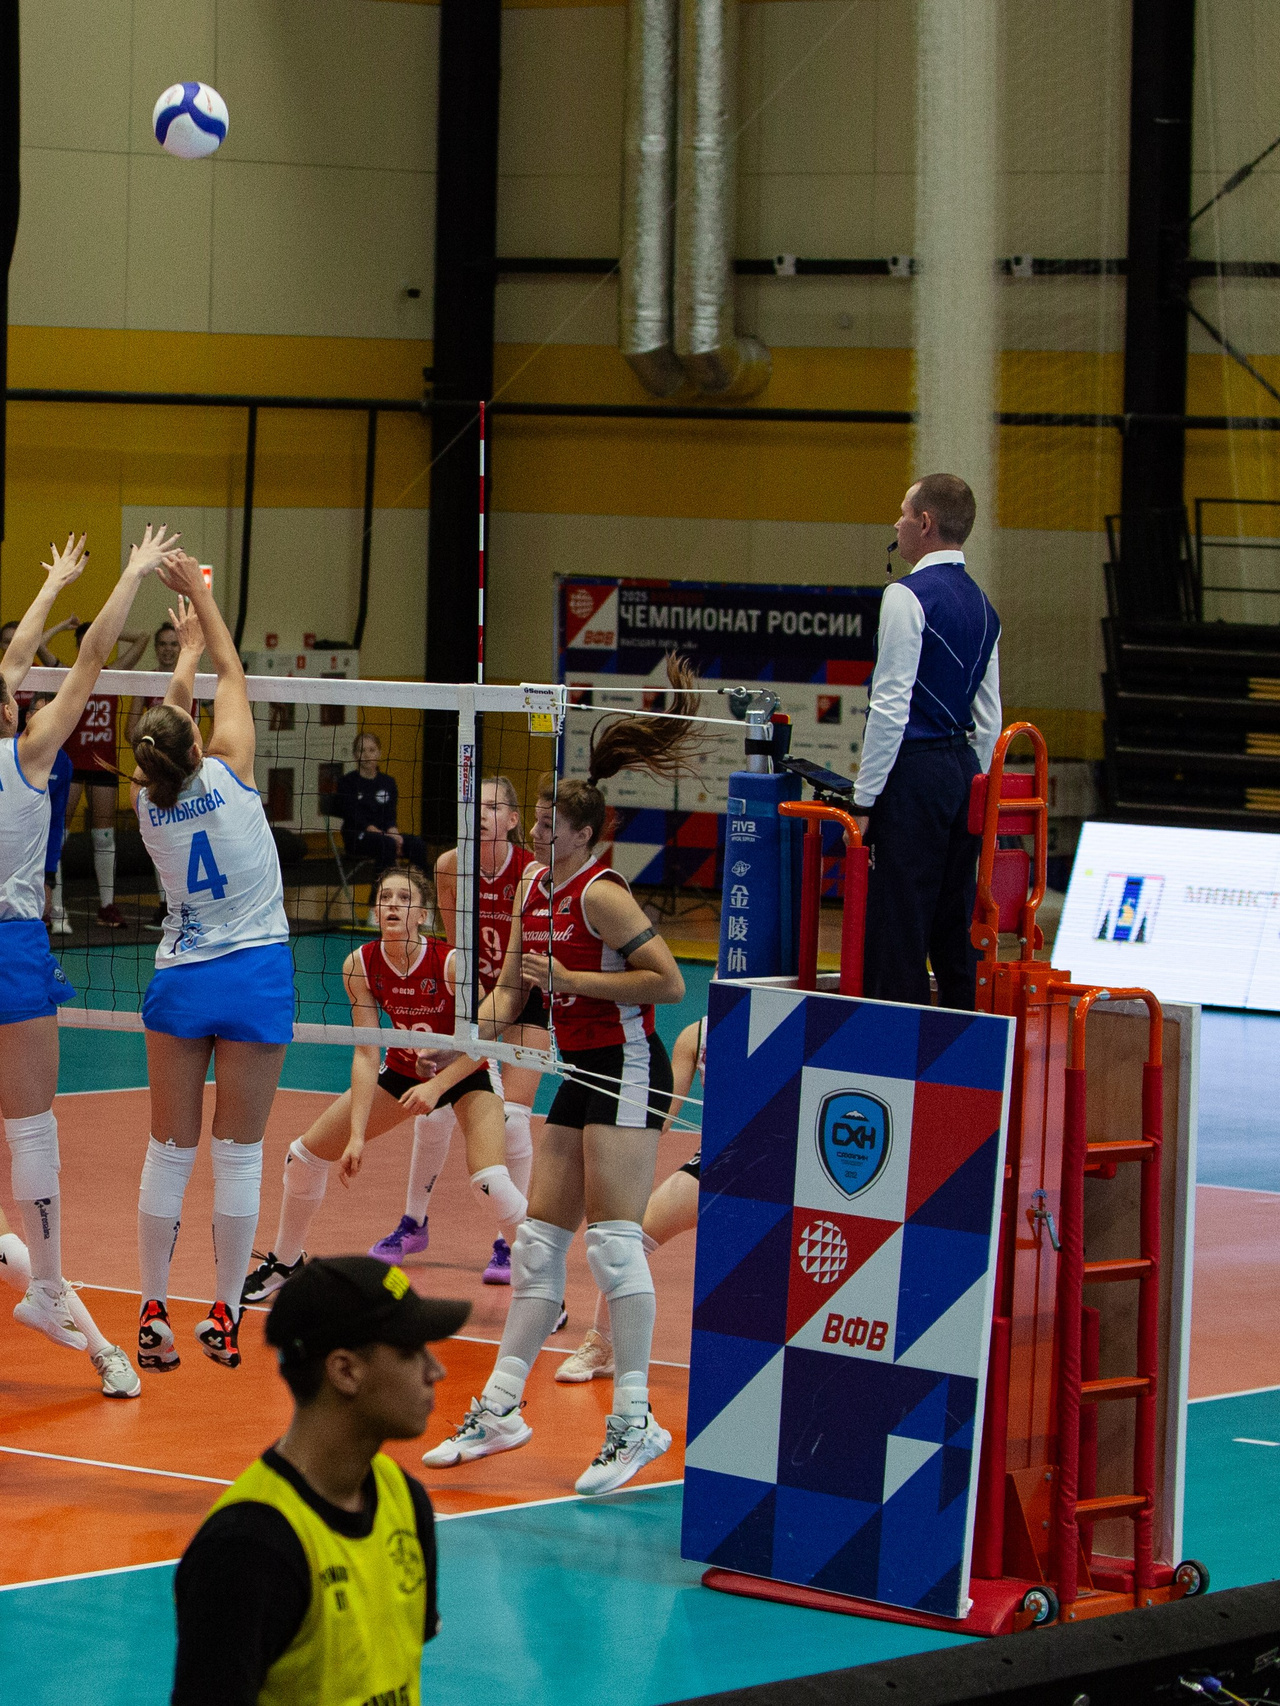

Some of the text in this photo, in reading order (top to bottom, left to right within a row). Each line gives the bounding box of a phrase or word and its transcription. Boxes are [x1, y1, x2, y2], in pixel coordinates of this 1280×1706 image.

[620, 604, 862, 637] ЧЕМПИОНАТ РОССИИ
[86, 700, 111, 727] 23
[148, 788, 226, 827] ЕРЛЫКОВА
[731, 820, 756, 833] FIVB
[187, 830, 229, 900] 4
[821, 1312, 889, 1352] ВФВ
